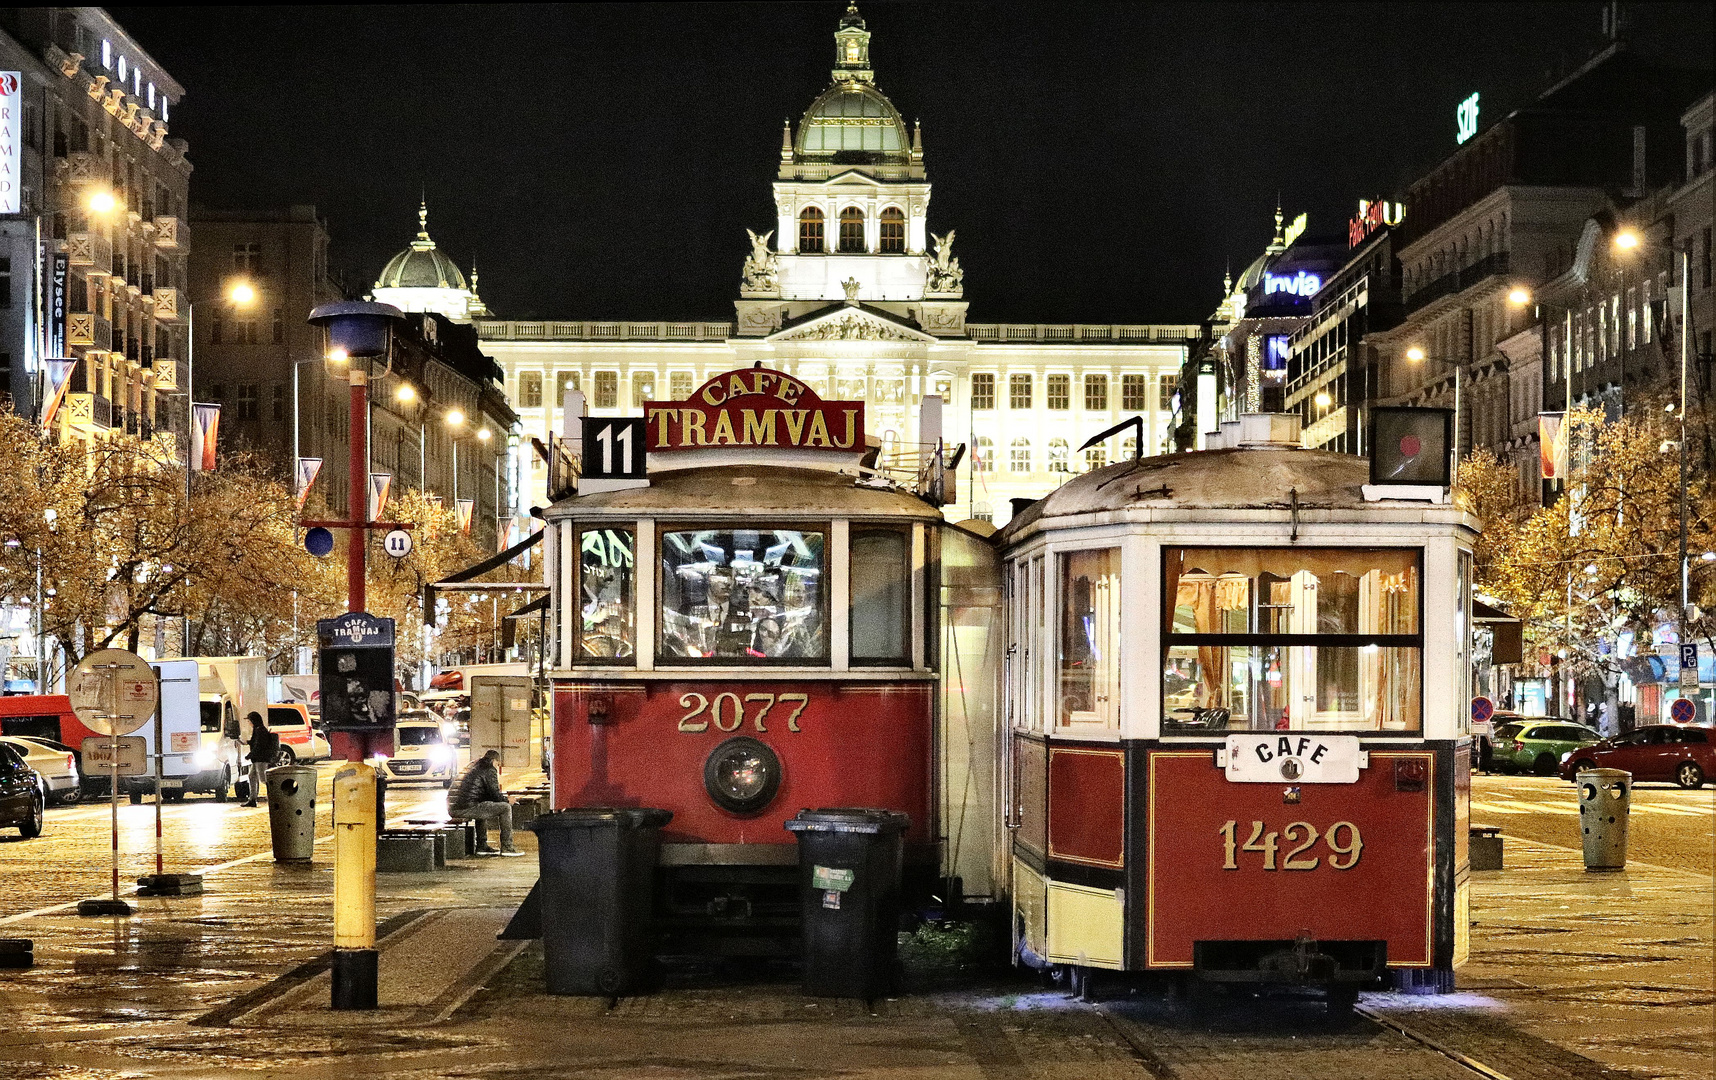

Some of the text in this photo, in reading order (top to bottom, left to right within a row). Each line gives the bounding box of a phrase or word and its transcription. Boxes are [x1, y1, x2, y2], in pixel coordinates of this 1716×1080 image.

[102, 39, 168, 122] HOTEL
[1457, 92, 1479, 144] SZIF
[0, 107, 12, 211] RAMADA
[1264, 271, 1320, 296] invia
[702, 372, 805, 406] CAFE
[649, 408, 859, 448] TRAMVAJ
[596, 424, 633, 474] 11
[391, 538, 404, 550] 11
[334, 626, 379, 637] TRAMVAJ
[344, 619, 368, 628] CAFE
[1683, 647, 1693, 662] P
[678, 692, 809, 732] 2077
[1255, 736, 1329, 765] CAFE
[1219, 820, 1363, 869] 1429
